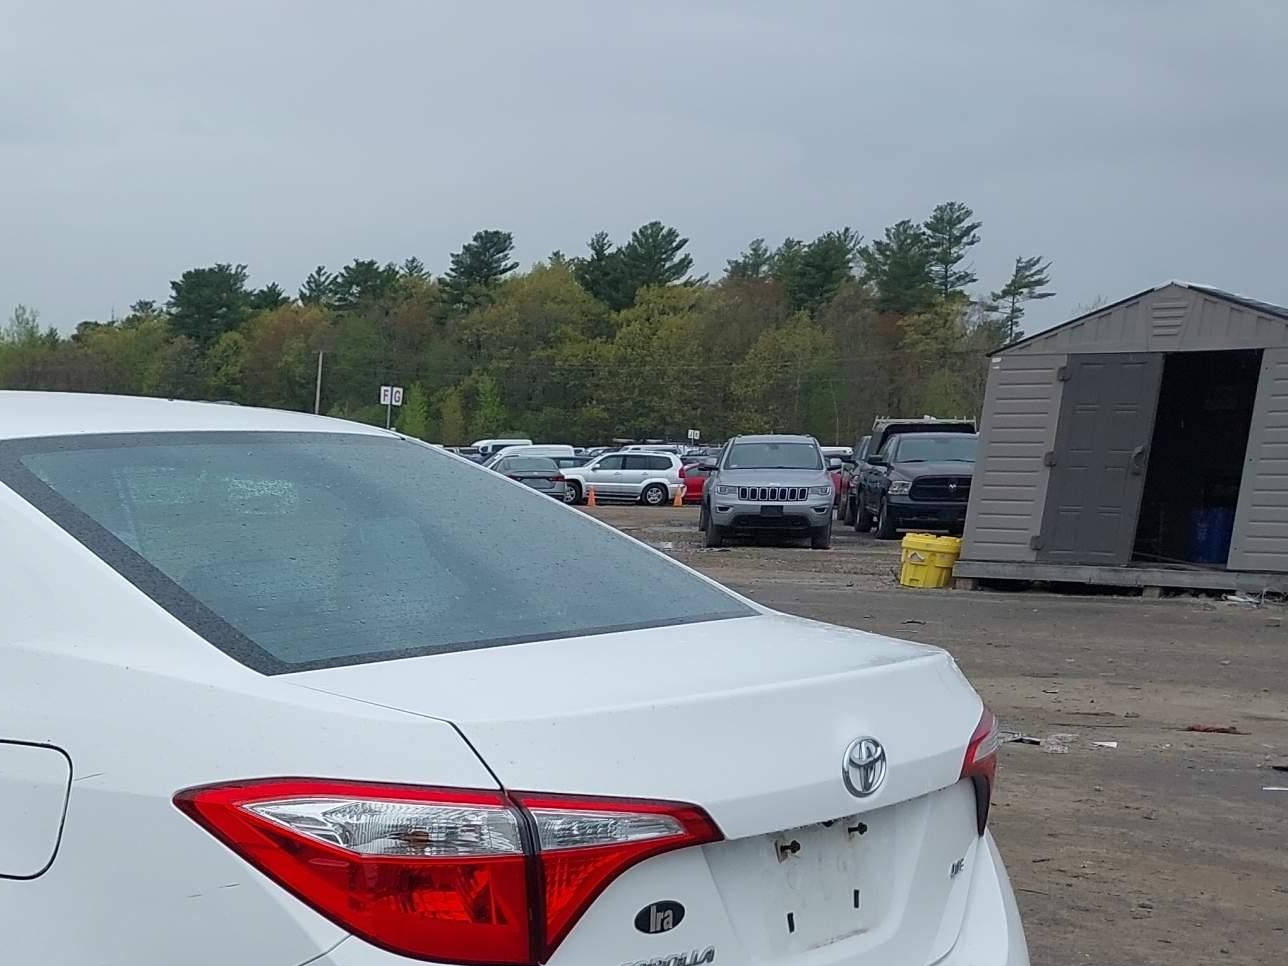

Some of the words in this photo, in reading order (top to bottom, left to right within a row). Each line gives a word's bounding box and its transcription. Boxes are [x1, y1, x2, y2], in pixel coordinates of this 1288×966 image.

[383, 388, 390, 402] F
[394, 390, 401, 403] G
[649, 905, 674, 933] Ira
